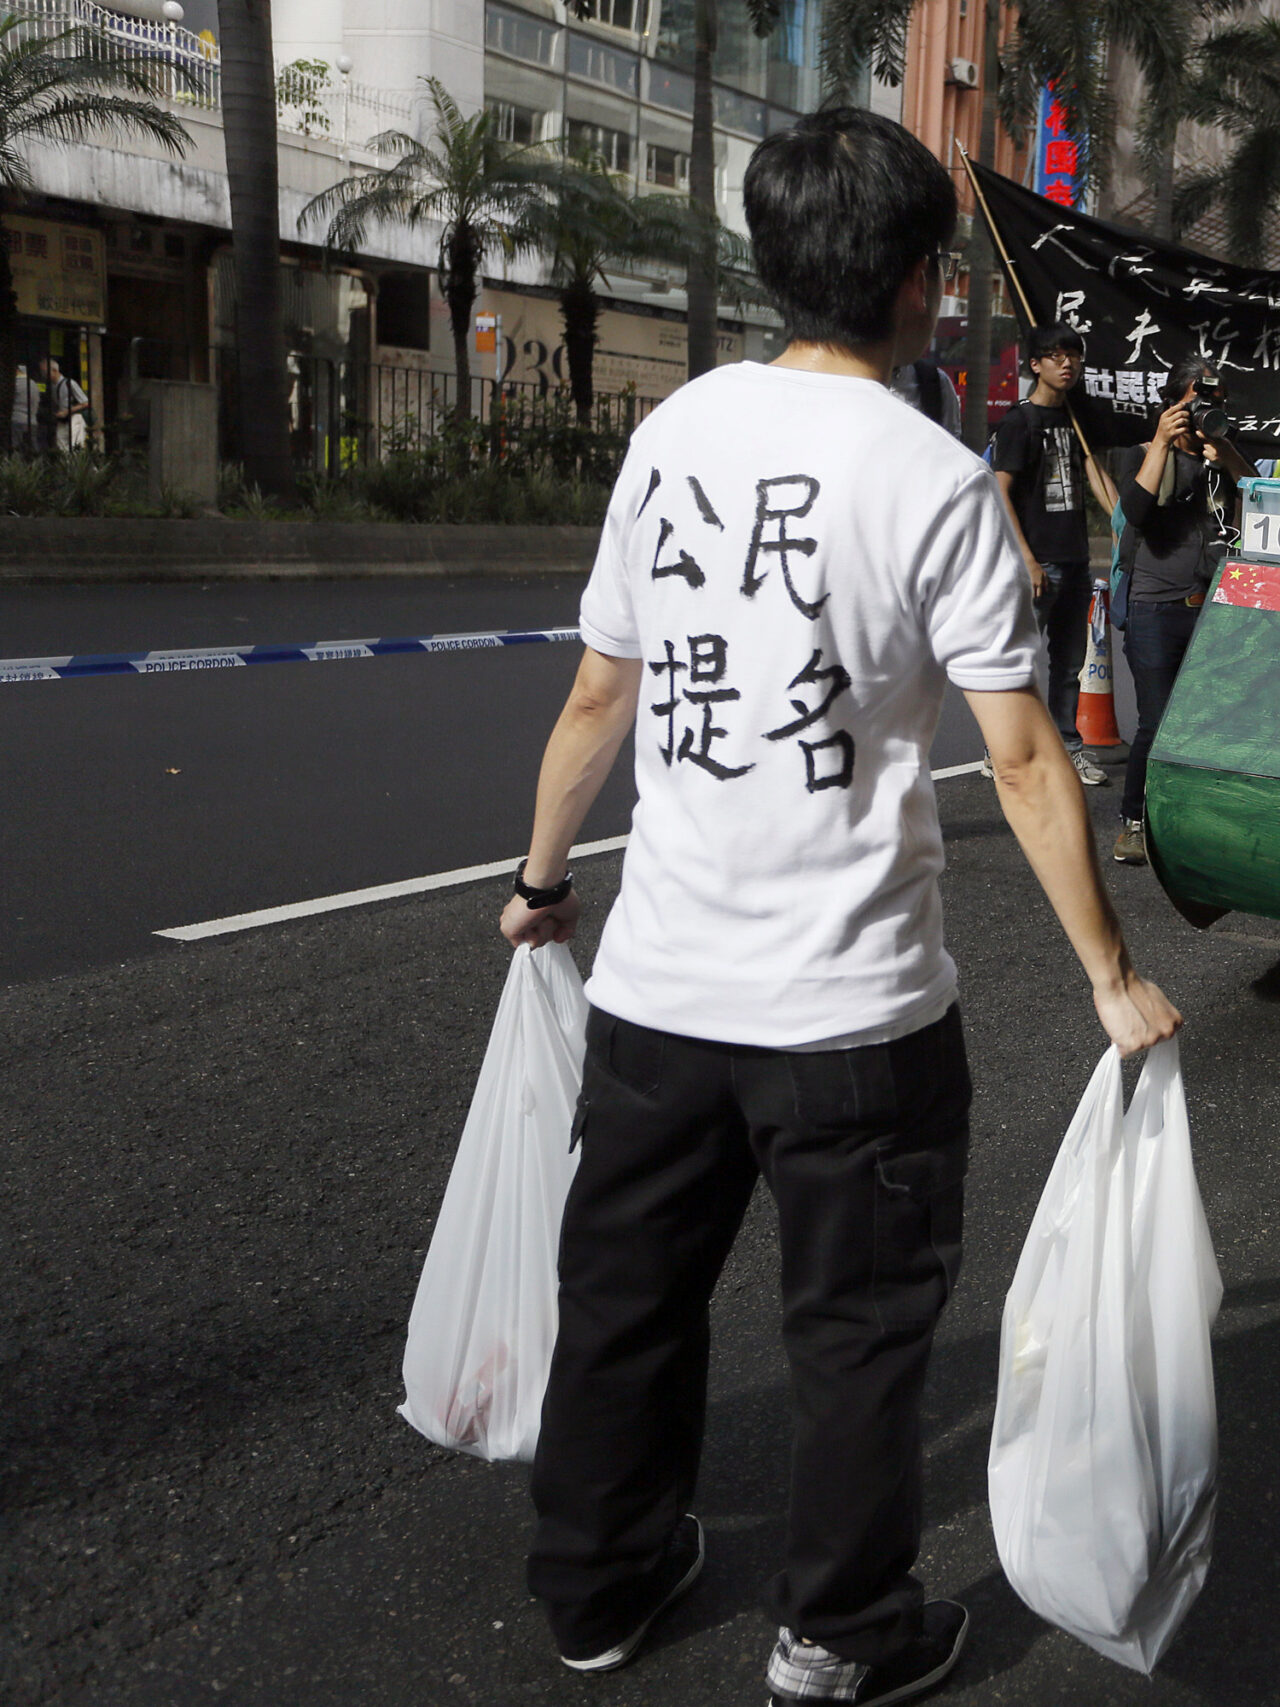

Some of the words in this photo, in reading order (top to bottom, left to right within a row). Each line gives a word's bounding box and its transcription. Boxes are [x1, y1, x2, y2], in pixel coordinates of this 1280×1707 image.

[637, 466, 831, 621] 公民
[145, 660, 187, 673] POLICE
[188, 657, 236, 671] CORDON
[430, 639, 460, 650] POLICE
[462, 637, 496, 649] CORDON
[648, 633, 856, 793] 提名
